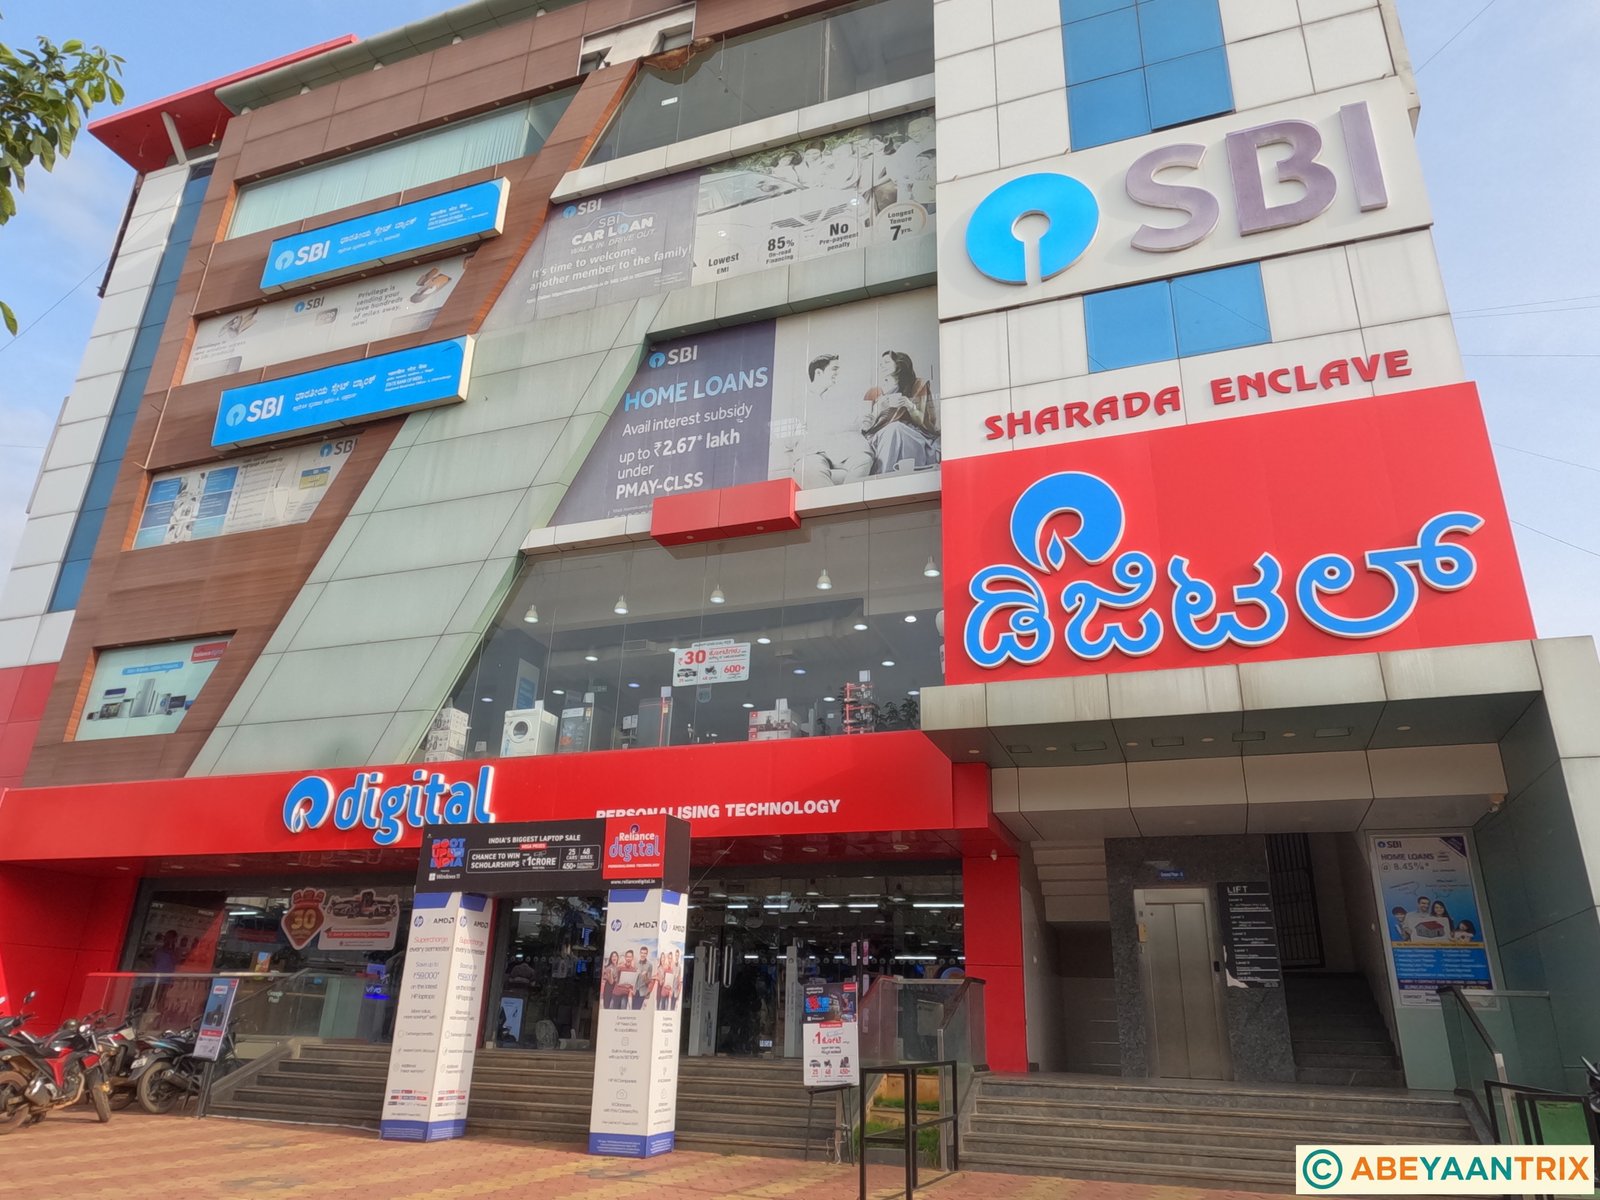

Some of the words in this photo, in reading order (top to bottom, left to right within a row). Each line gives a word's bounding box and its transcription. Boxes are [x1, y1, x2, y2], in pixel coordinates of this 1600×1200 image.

[1125, 100, 1389, 253] SBI
[578, 198, 602, 216] SBI
[887, 208, 914, 219] Longest
[599, 215, 621, 228] SBI
[890, 215, 913, 225] Tenure
[571, 229, 605, 246] CAR
[829, 222, 849, 237] No
[767, 236, 795, 252] 85%
[819, 232, 859, 246] Pre-payment
[826, 241, 851, 252] penalty
[295, 240, 331, 266] SBI
[708, 252, 740, 267] Lowest
[765, 254, 794, 265] Financing
[529, 275, 570, 292] another
[572, 264, 616, 281] member
[619, 260, 630, 270] to
[633, 253, 651, 267] the
[654, 243, 692, 262] family!
[532, 265, 547, 280] It's
[550, 261, 573, 274] time
[576, 258, 587, 268] to
[589, 246, 637, 265] welcome
[716, 266, 730, 275] EMI
[304, 296, 325, 311] SBI
[668, 345, 698, 365] SBI
[624, 382, 688, 412] HOME
[693, 367, 769, 399] LOANS
[985, 385, 1181, 440] SHARADA
[1210, 348, 1413, 405] ENCLAVE
[247, 395, 285, 422] SBI
[622, 420, 651, 437] Avail
[652, 412, 701, 431] interest
[703, 403, 753, 421] subsidy
[619, 451, 634, 465] up
[637, 448, 650, 461] to
[706, 428, 740, 449] lakh
[617, 464, 654, 480] under
[616, 471, 704, 500] PMAY-CLSS
[964, 511, 1486, 670] ಡಿಜಿಟಲ್
[333, 765, 496, 846] digital
[725, 799, 841, 817] TECHNOLOGY
[488, 836, 511, 845] INDIA'S
[512, 836, 539, 844] BIGGEST
[539, 835, 564, 843] LAPTOP
[618, 831, 655, 842] Reliance
[608, 834, 661, 863] digital
[1386, 841, 1402, 849] SBI
[471, 853, 497, 861] CHANCE
[497, 852, 506, 860] TO
[471, 861, 520, 869] SCHOLARSHIPS
[1227, 885, 1249, 894] LIFT
[291, 909, 317, 930] 30
[633, 921, 652, 929] AMD
